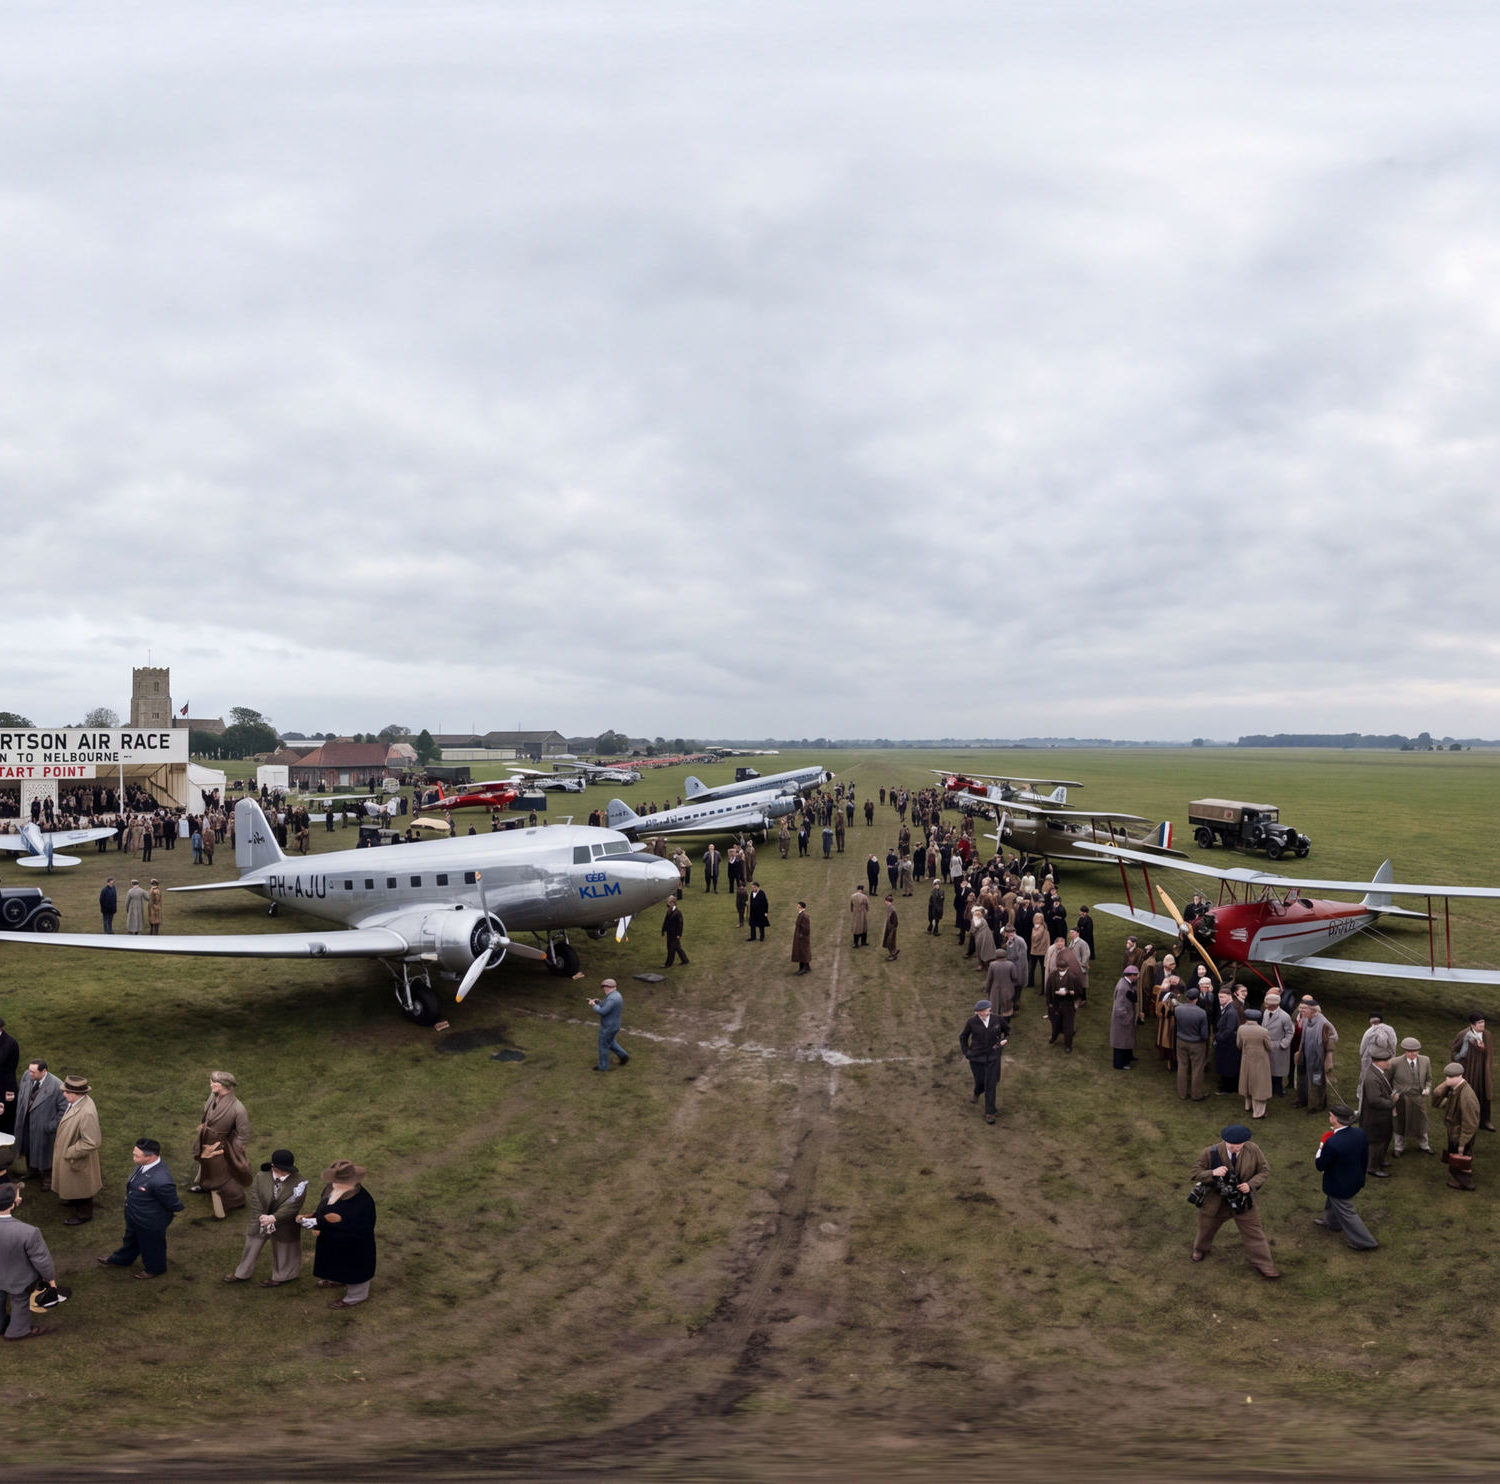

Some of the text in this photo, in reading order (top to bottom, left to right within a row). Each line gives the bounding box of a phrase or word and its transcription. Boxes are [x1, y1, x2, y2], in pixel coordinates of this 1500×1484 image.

[78, 733, 111, 750] AIR
[120, 733, 171, 750] RACE
[16, 752, 34, 763] TO
[43, 766, 86, 778] POINT
[269, 874, 327, 899] PH-AJU
[578, 881, 622, 900] KLM
